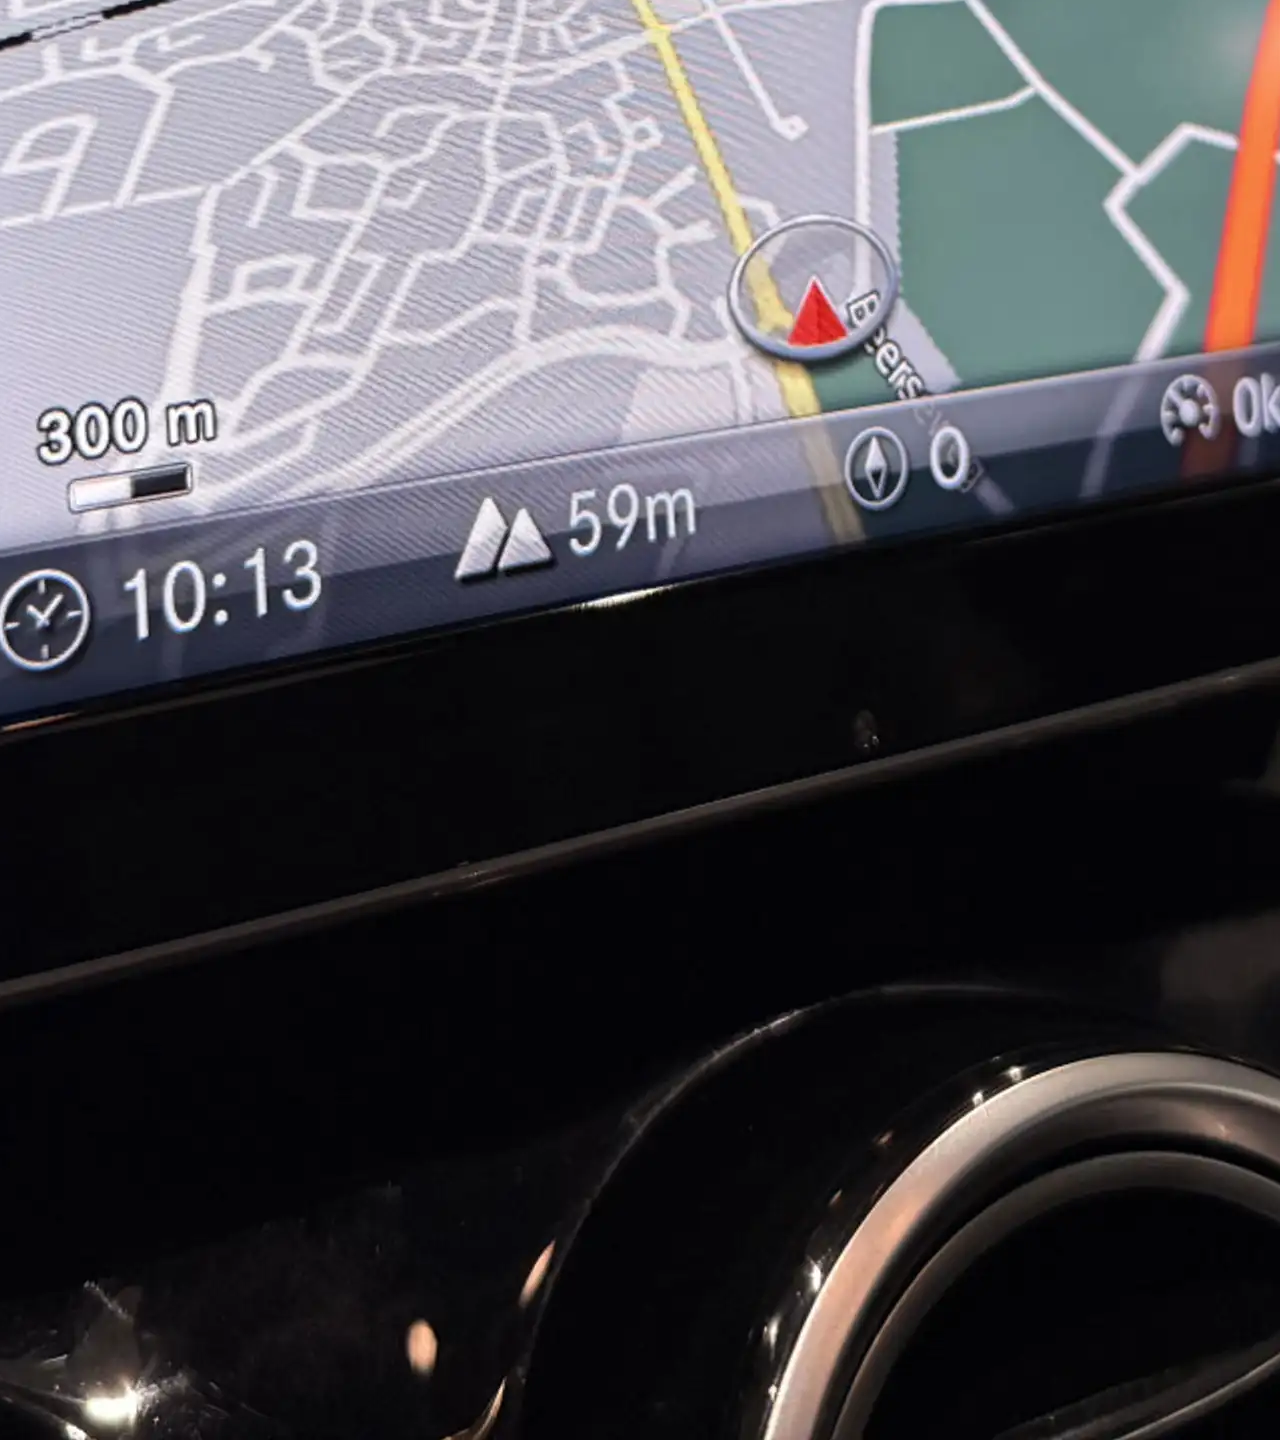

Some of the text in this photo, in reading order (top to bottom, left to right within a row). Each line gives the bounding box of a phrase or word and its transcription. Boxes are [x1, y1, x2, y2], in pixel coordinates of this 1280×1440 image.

[37, 396, 217, 465] 300 m
[929, 426, 970, 491] 0
[568, 483, 697, 556] 59m
[124, 539, 322, 641] 10:13
